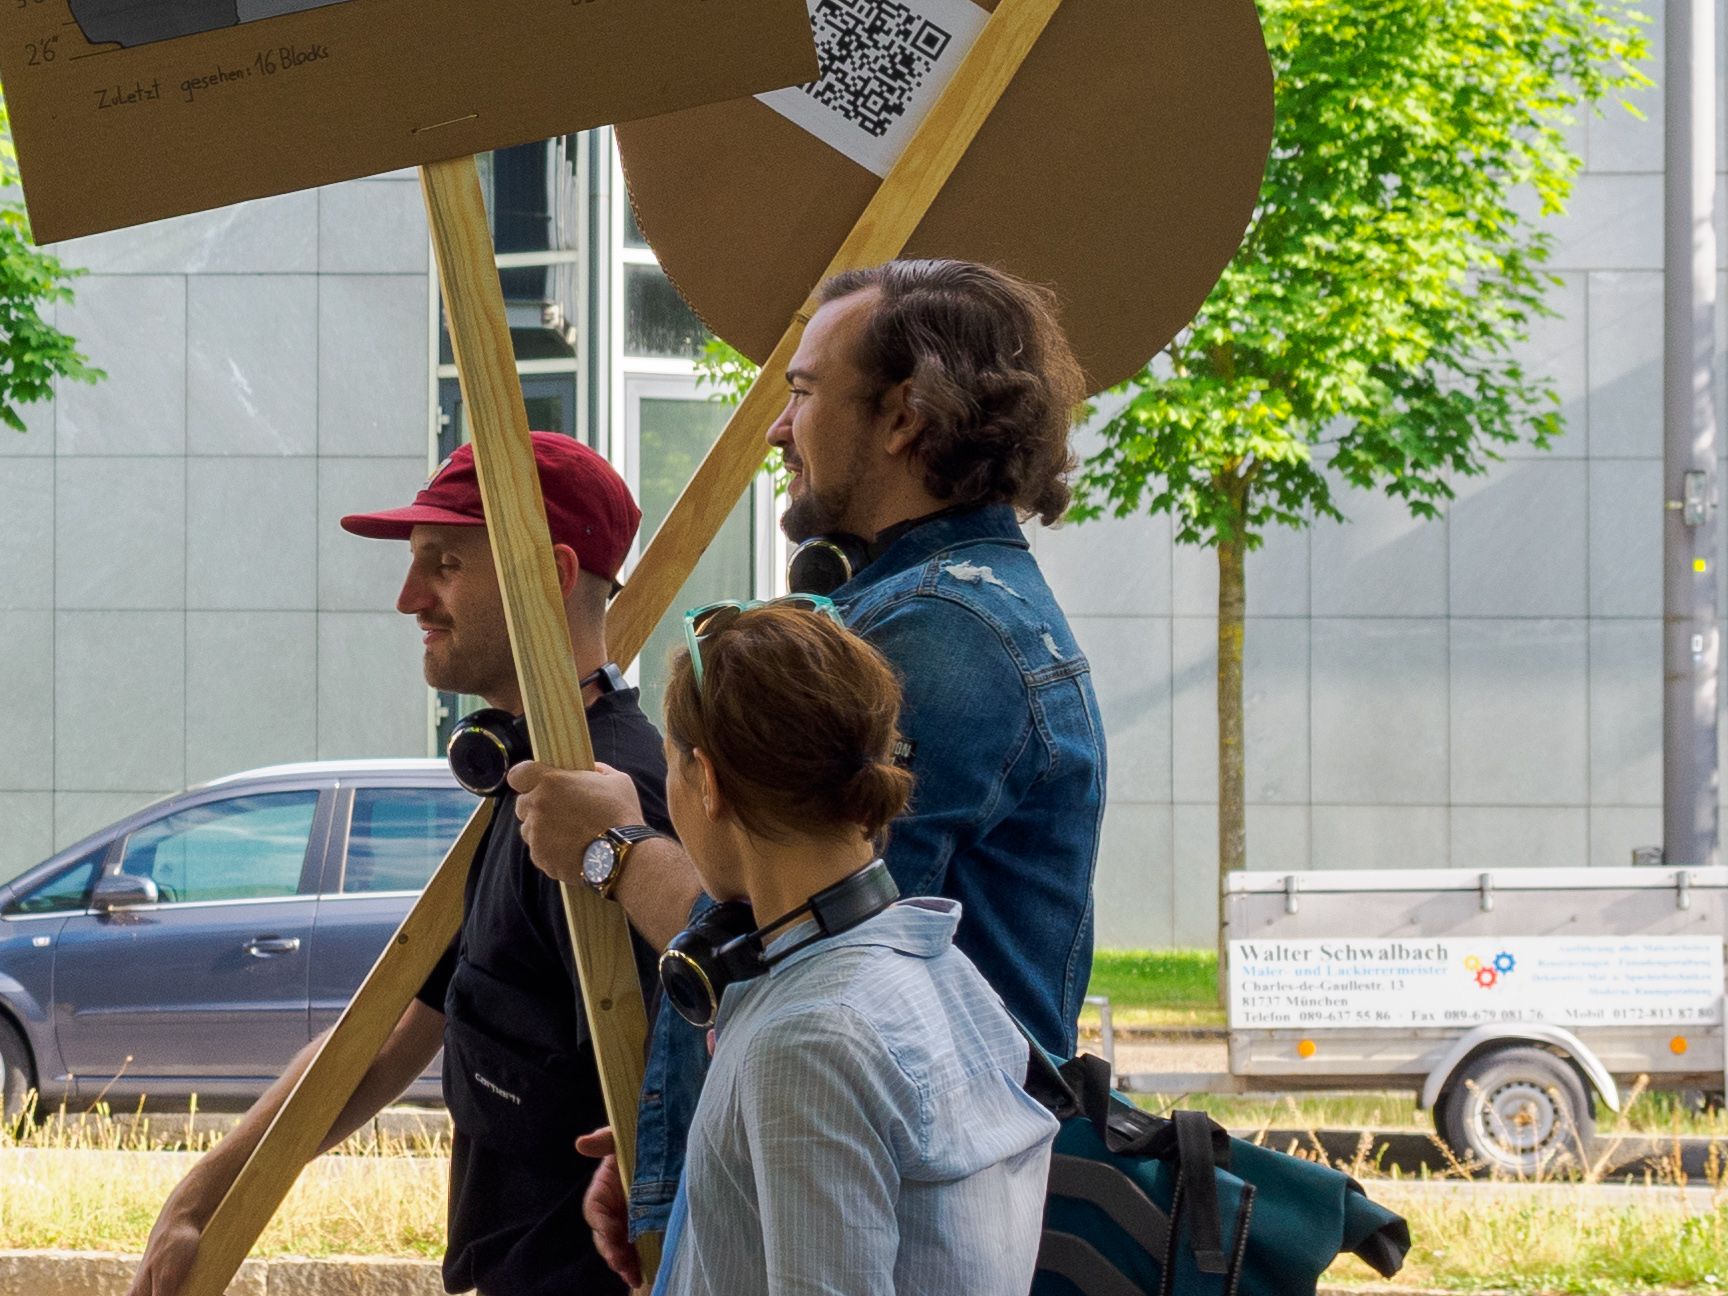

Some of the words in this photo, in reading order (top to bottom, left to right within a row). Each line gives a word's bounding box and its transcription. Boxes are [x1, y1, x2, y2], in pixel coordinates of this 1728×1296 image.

[180, 65, 253, 103] gesehen:
[1240, 944, 1313, 962] Walter
[1320, 943, 1449, 962] Schwalbach
[1295, 965, 1321, 977] und
[1286, 995, 1349, 1007] München
[1244, 1010, 1291, 1022] Telefon
[1411, 1009, 1435, 1021] Fax
[1565, 1007, 1605, 1019] Mobil
